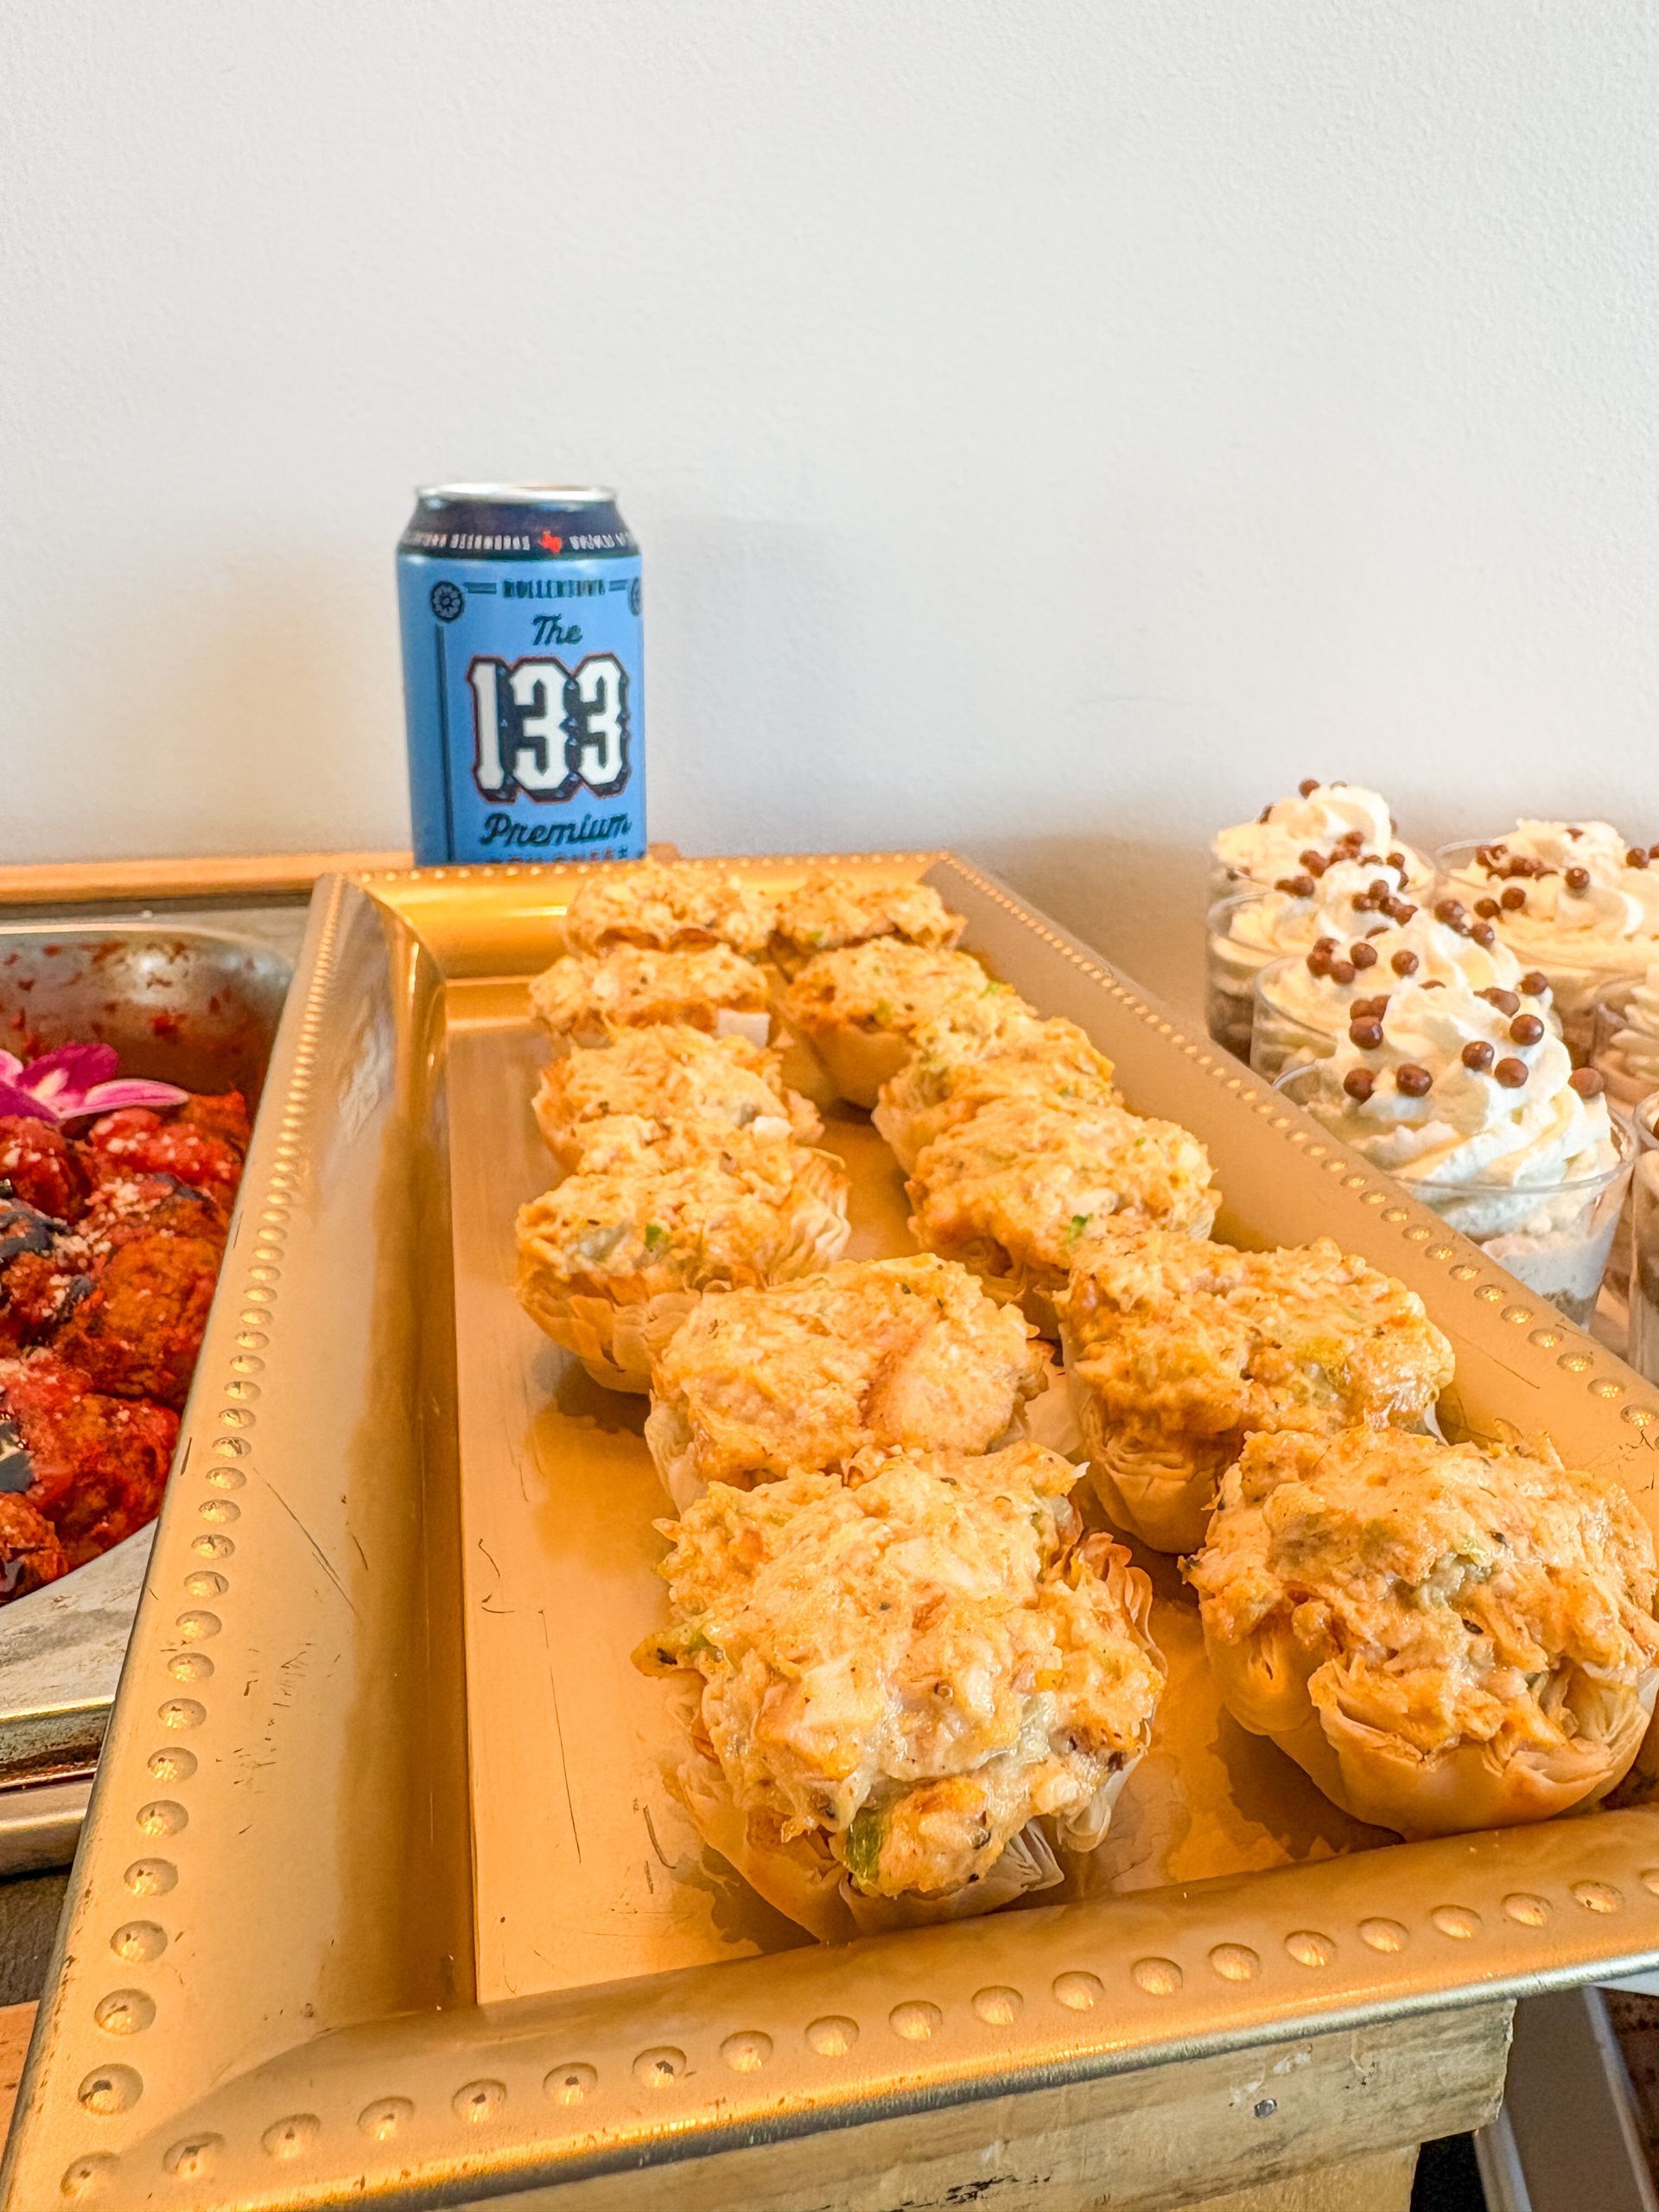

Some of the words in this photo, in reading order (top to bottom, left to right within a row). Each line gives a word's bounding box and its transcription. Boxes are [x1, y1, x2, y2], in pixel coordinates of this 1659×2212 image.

[532, 613, 583, 645] The
[468, 654, 629, 802] 133
[480, 812, 632, 848] Premium
